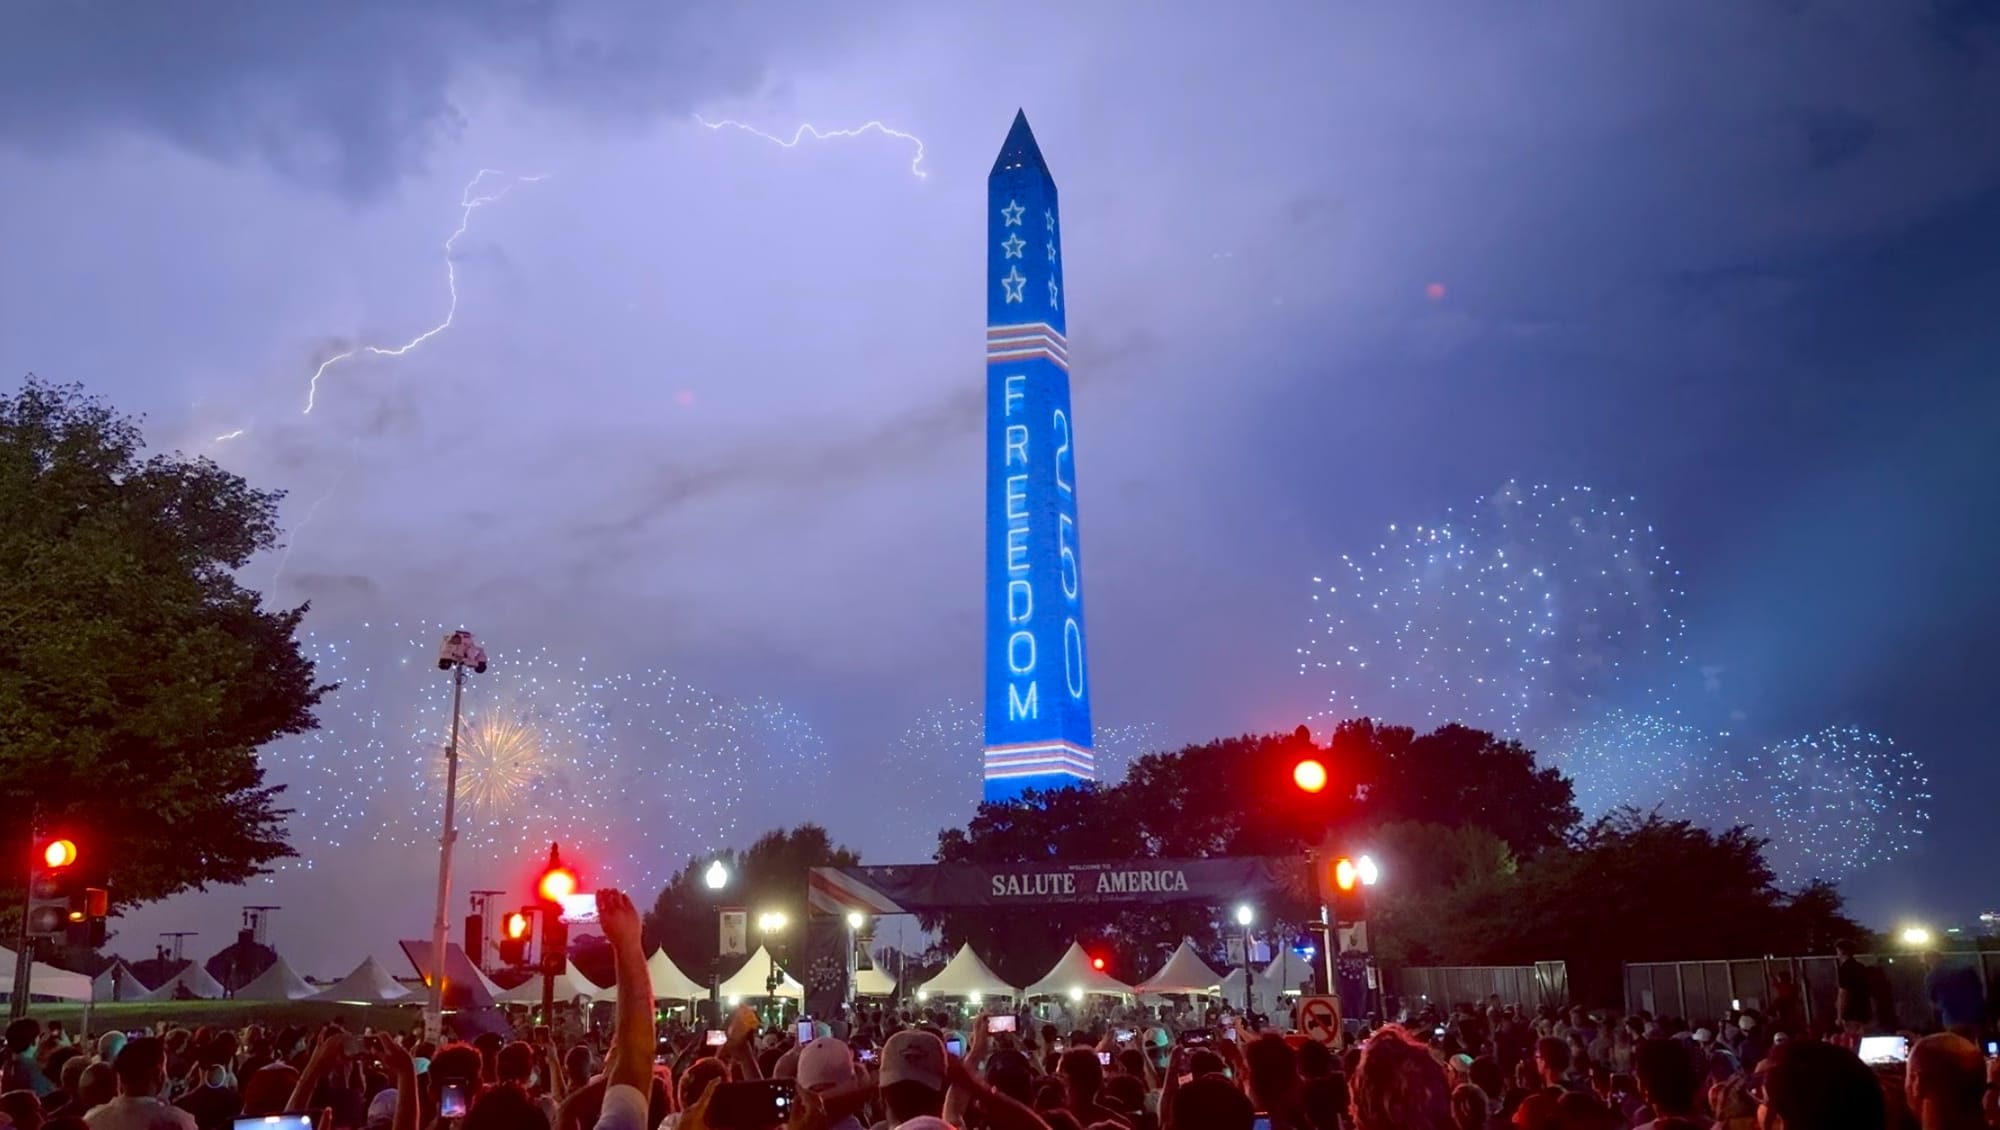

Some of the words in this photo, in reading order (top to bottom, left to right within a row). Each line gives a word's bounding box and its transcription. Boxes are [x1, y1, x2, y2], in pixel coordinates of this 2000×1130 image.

[1005, 375, 1038, 721] FREEDOM
[1053, 409, 1083, 699] 250
[991, 873, 1076, 896] SALUTE
[1096, 870, 1189, 893] AMERICA
